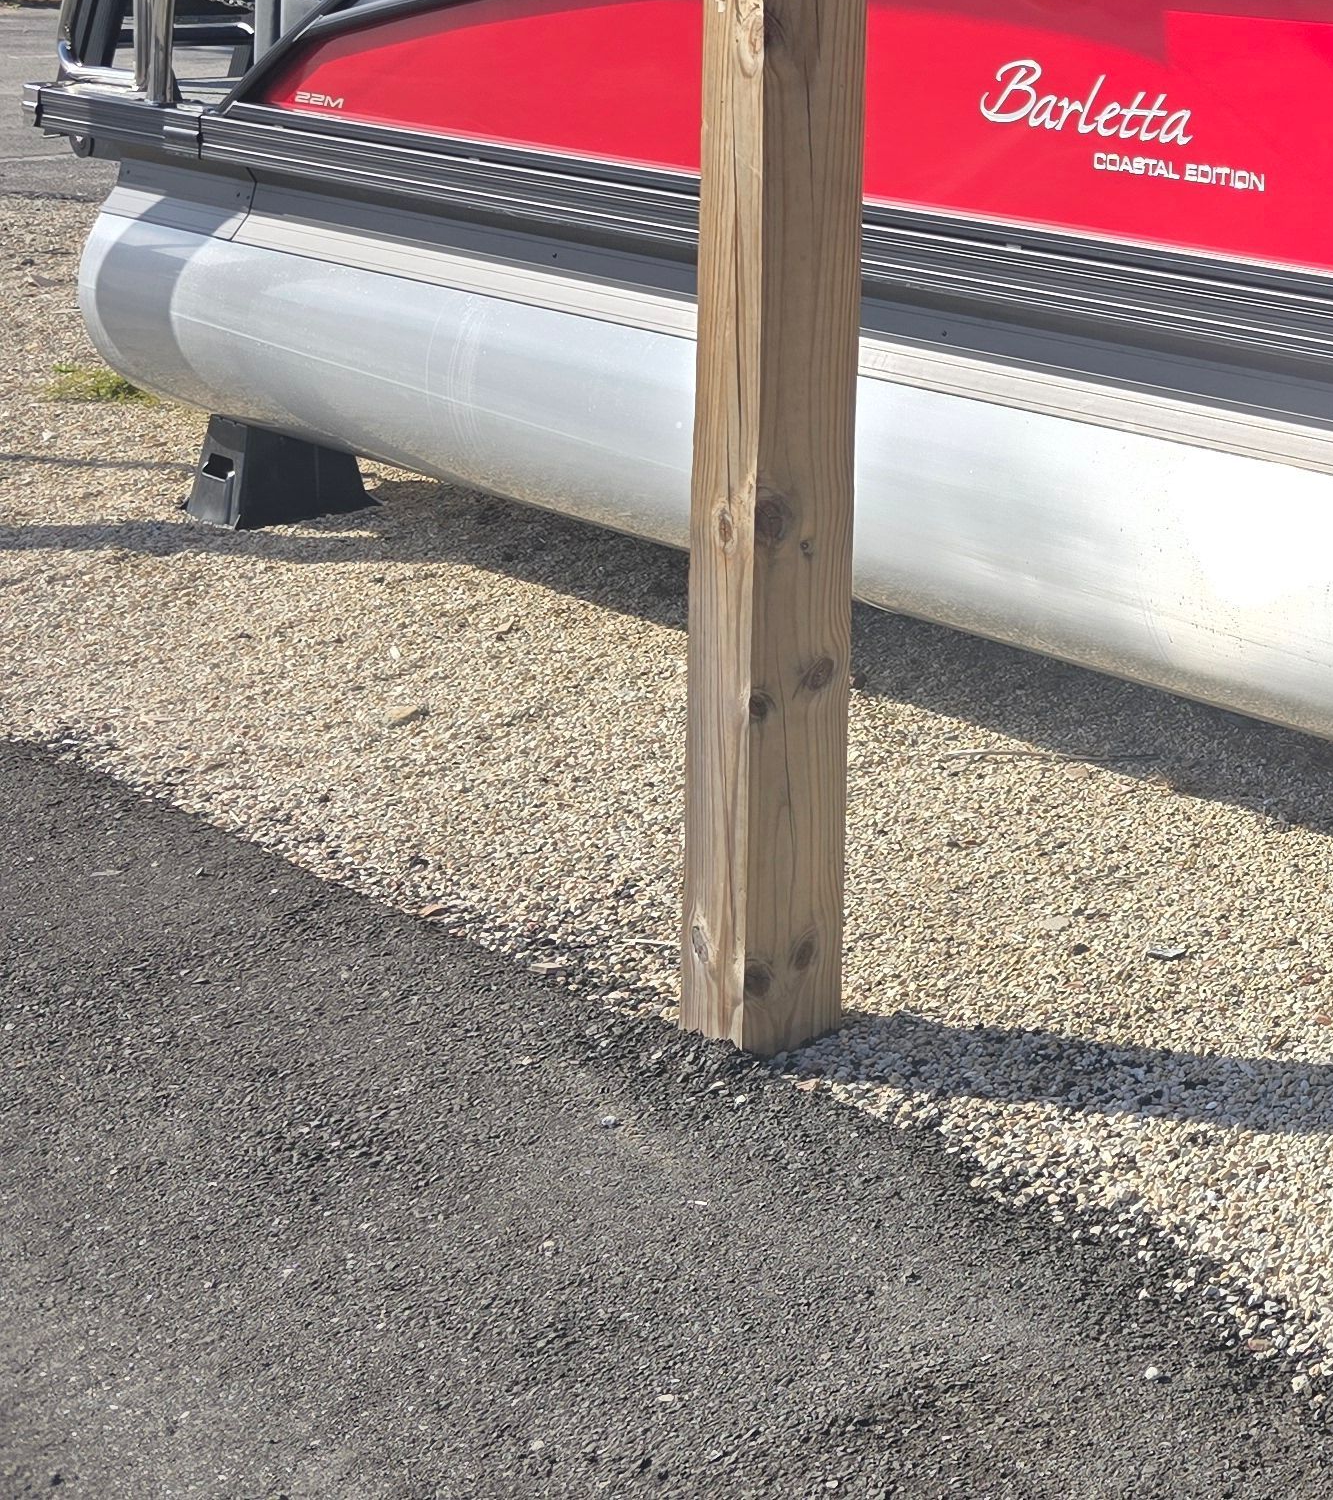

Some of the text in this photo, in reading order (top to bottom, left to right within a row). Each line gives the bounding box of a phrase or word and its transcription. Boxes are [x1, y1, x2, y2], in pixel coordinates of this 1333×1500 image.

[294, 90, 345, 109] 22M
[979, 59, 1193, 146] Barletta
[1093, 152, 1265, 192] COASTAL EDITION
